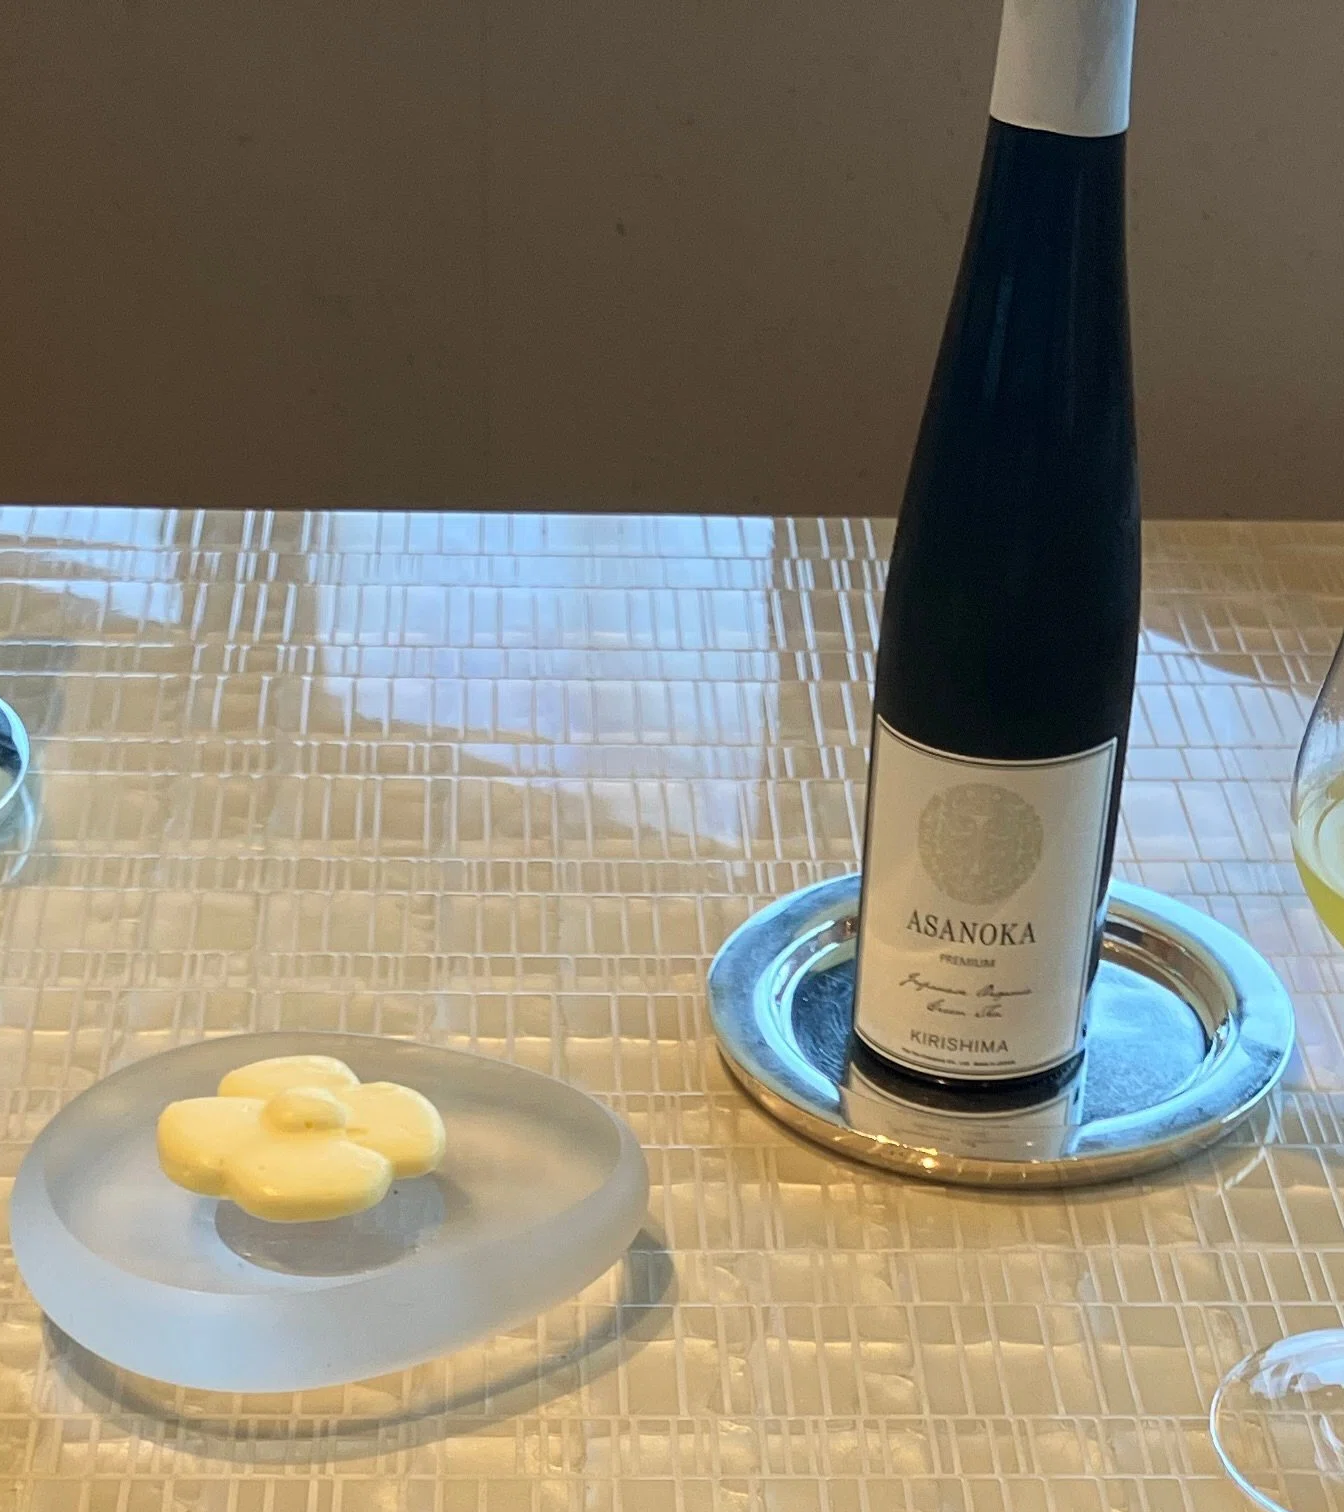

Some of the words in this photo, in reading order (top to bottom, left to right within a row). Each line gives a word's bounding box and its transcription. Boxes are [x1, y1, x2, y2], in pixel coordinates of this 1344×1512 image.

[907, 909, 1037, 946] ASANOKA
[940, 953, 997, 969] PREMIUM
[910, 1029, 1009, 1053] KIRISHIMA
